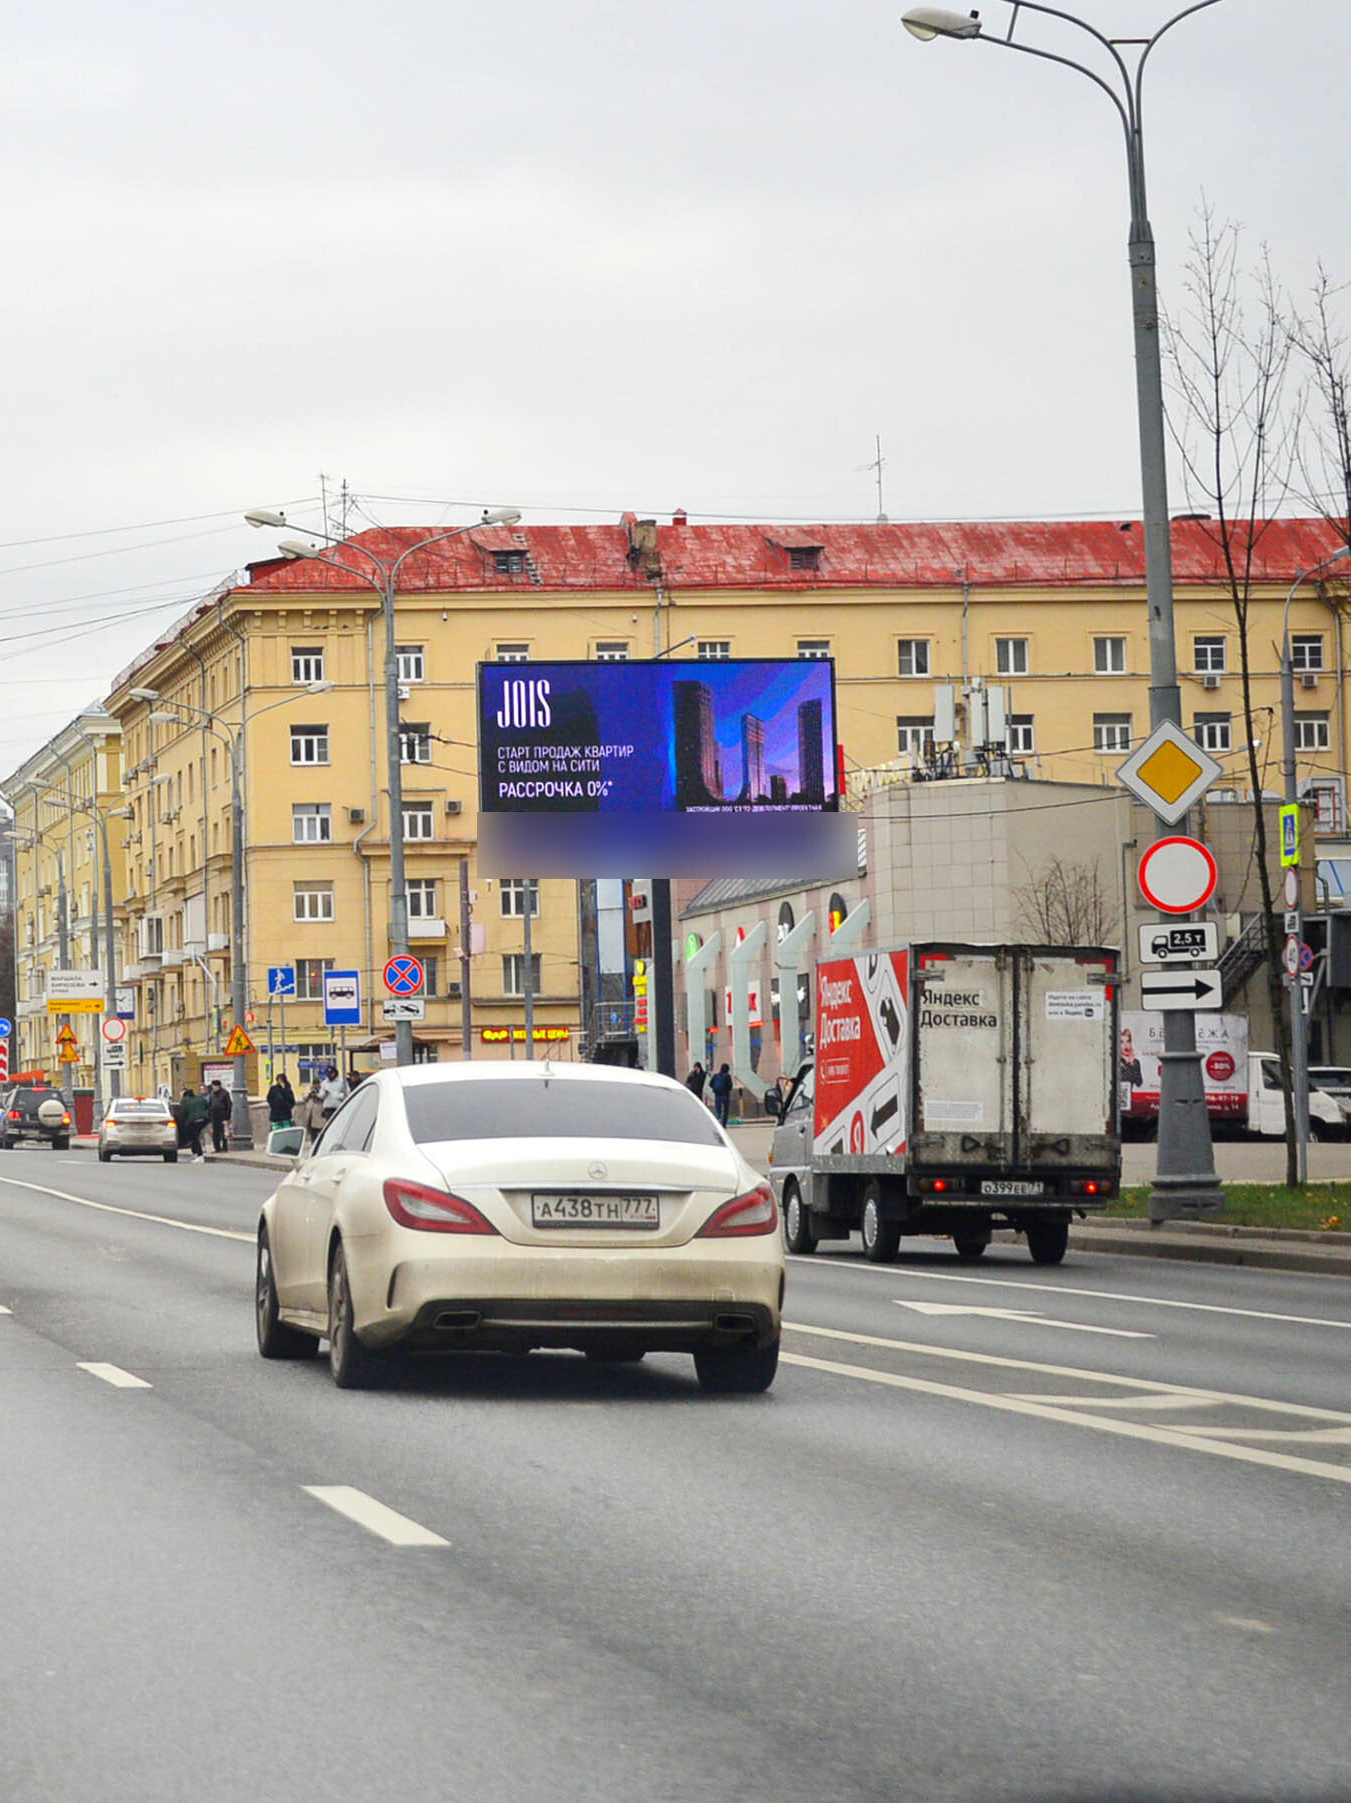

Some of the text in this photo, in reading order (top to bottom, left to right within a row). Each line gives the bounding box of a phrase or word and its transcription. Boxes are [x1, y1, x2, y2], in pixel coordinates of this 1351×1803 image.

[497, 679, 551, 728] JOIS
[497, 745, 634, 759] СТАРТ ПРОДАЖ КВАРТИР
[497, 760, 600, 773] С ВИДОМ НА СИТИ
[499, 782, 584, 798] РАССРОЧКА
[1173, 932, 1192, 945] 2,5
[821, 976, 853, 1010] Яндекс
[923, 989, 980, 1007] Яндекс
[921, 1010, 997, 1028] Доставка
[820, 1013, 861, 1050] Доставка
[541, 1198, 652, 1218] А438ТН 777
